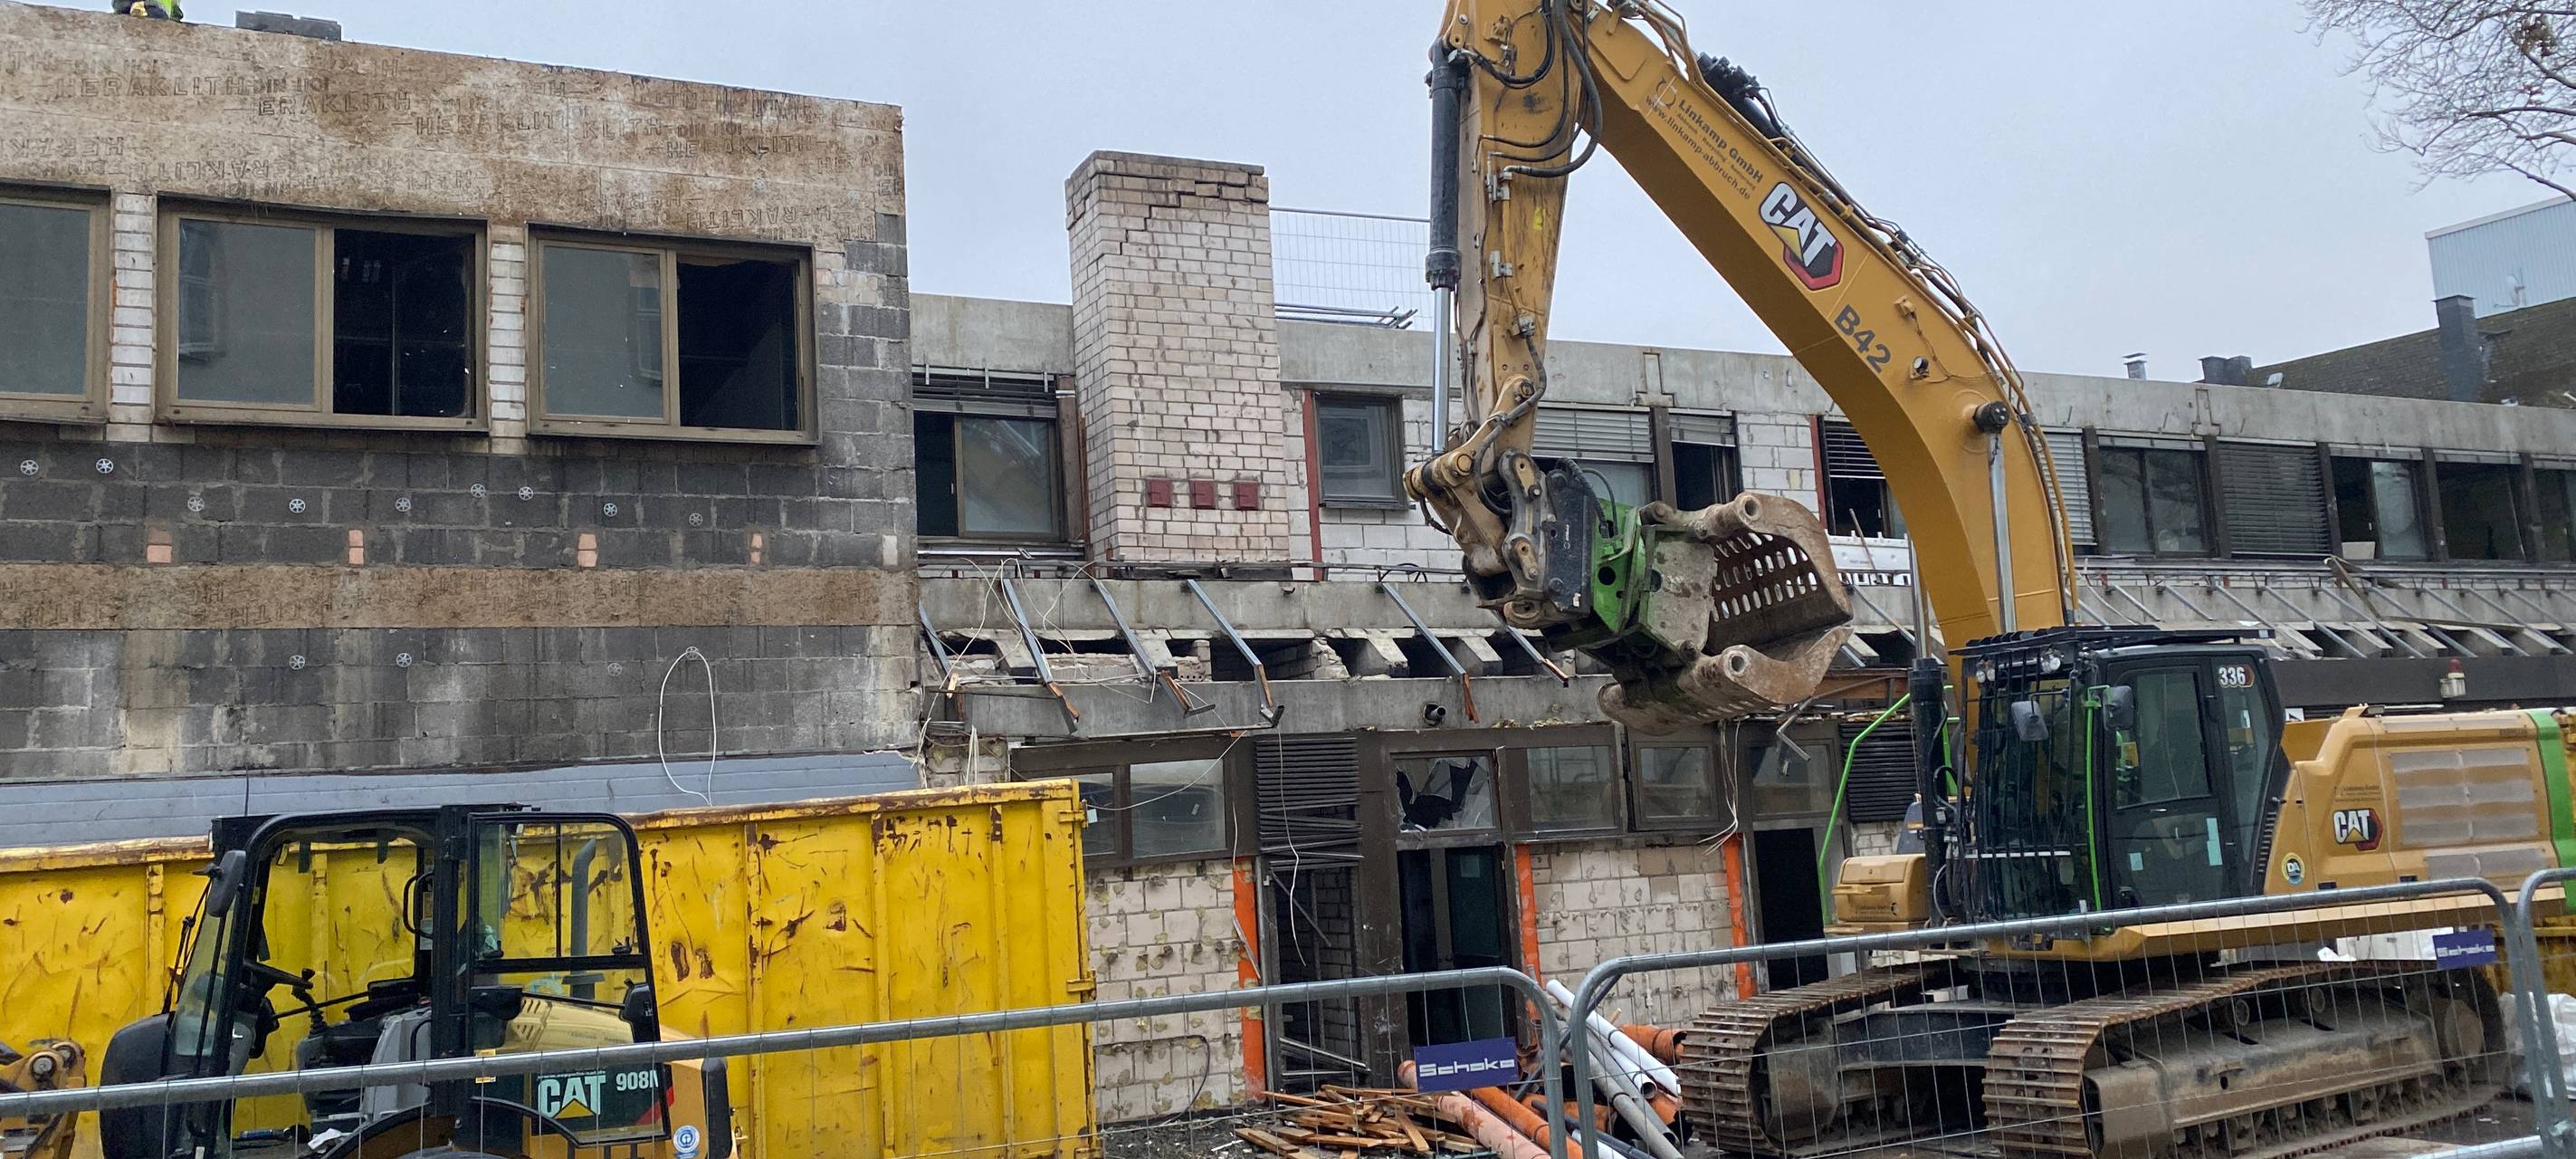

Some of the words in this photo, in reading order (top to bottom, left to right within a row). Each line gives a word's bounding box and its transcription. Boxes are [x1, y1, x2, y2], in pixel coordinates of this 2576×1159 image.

[1678, 100, 1727, 149] Linkamp
[1729, 148, 1763, 182] GmbH
[1760, 182, 1837, 268] CAT
[1834, 303, 1892, 374] B42
[2218, 666, 2246, 685] 336
[2333, 809, 2370, 844] CAT
[1419, 1058, 1515, 1078] Schake
[538, 1075, 606, 1118] CAT
